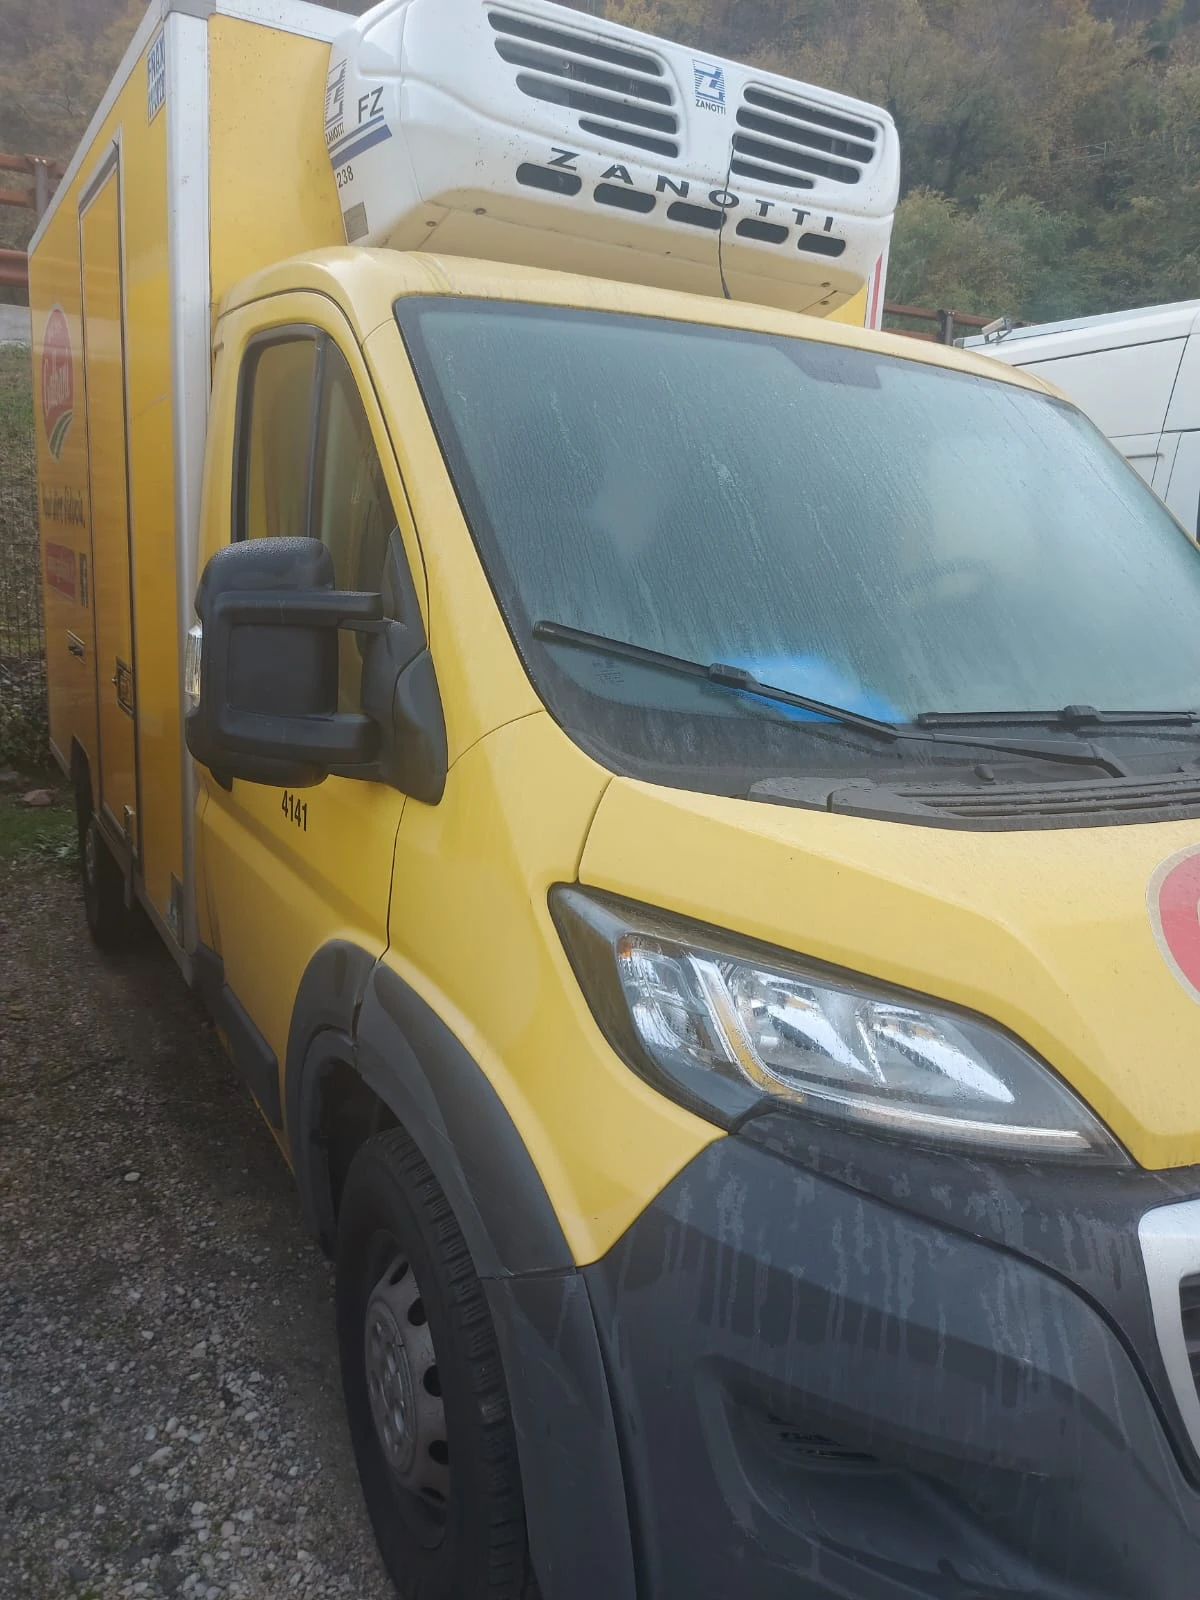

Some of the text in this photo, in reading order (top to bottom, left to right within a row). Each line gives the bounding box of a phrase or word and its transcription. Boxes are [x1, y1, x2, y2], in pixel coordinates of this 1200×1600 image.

[358, 86, 384, 125] FZ
[695, 98, 726, 116] ZANOTTI
[336, 165, 354, 189] 238
[547, 147, 834, 232] ZANOTTI
[281, 789, 307, 832] 4141
